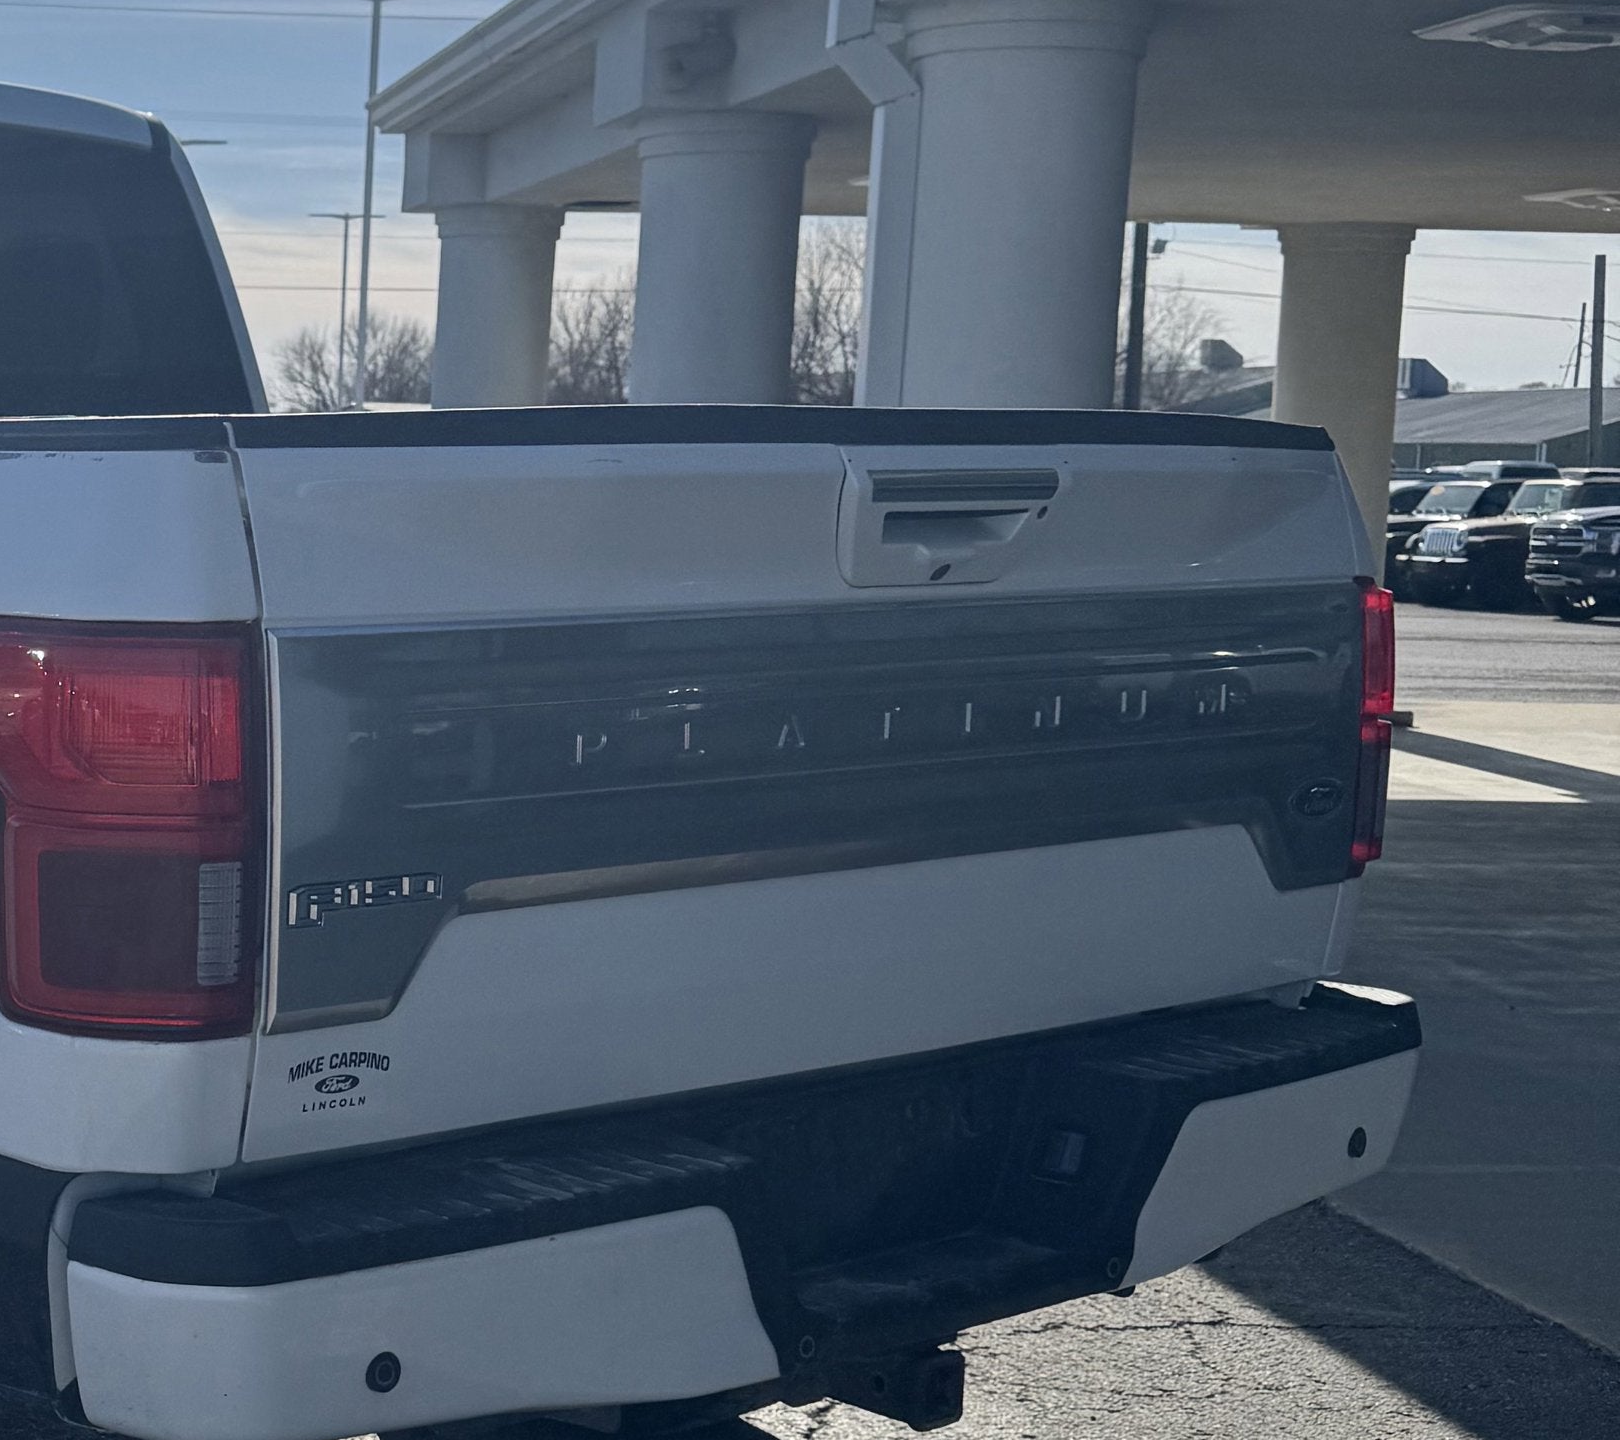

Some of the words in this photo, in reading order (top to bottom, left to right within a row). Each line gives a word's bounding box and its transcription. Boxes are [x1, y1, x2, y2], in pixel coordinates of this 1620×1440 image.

[288, 1056, 325, 1083] MIKE
[329, 1051, 390, 1072] CARPINO
[302, 1095, 366, 1113] LINCOLN
